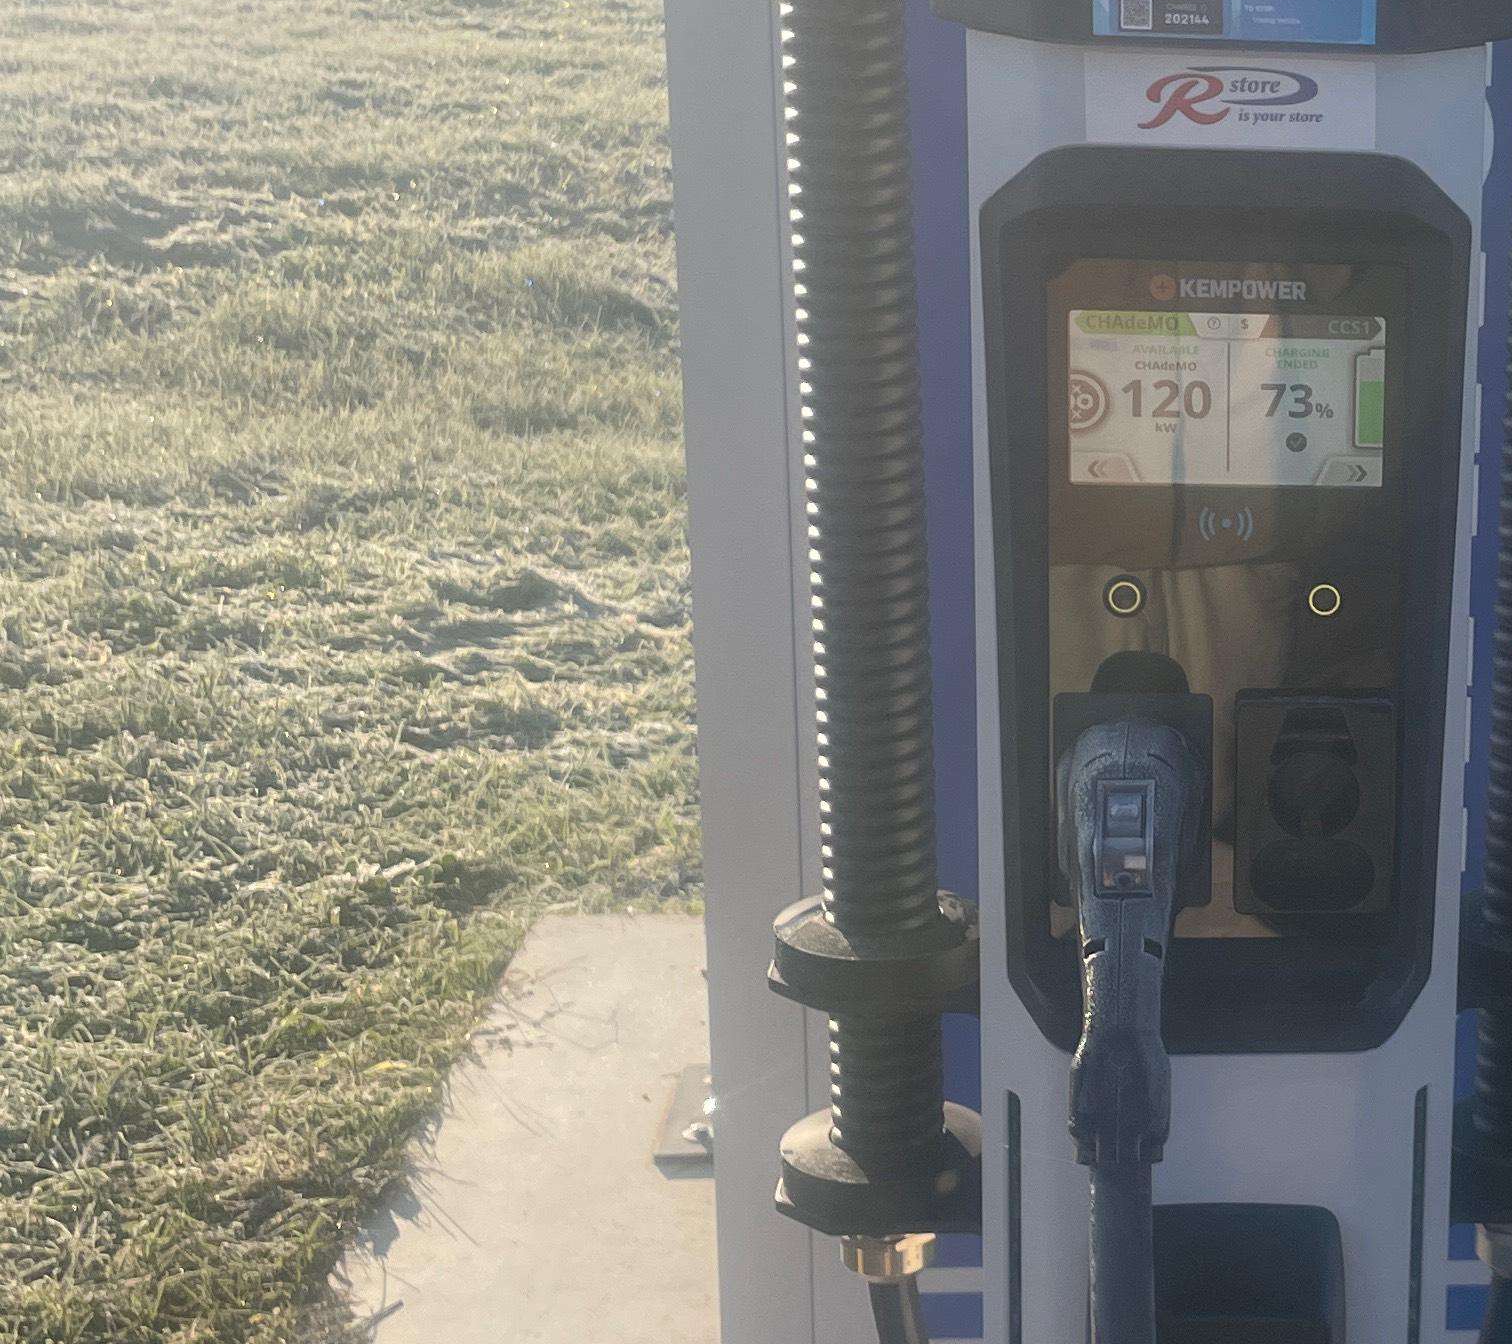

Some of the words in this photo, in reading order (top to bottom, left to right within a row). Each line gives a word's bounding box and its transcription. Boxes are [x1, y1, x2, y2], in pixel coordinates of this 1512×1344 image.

[1229, 77, 1281, 94] store
[1238, 110, 1250, 123] is
[1252, 113, 1286, 126] your
[1289, 112, 1323, 123] store
[1179, 278, 1306, 300] KEMPOWER
[1086, 315, 1179, 331] CHAdeMO
[1328, 320, 1372, 336] CCS1
[1135, 360, 1198, 372] CHAdeMO
[1121, 378, 1213, 420] 120
[1155, 422, 1178, 434] kW
